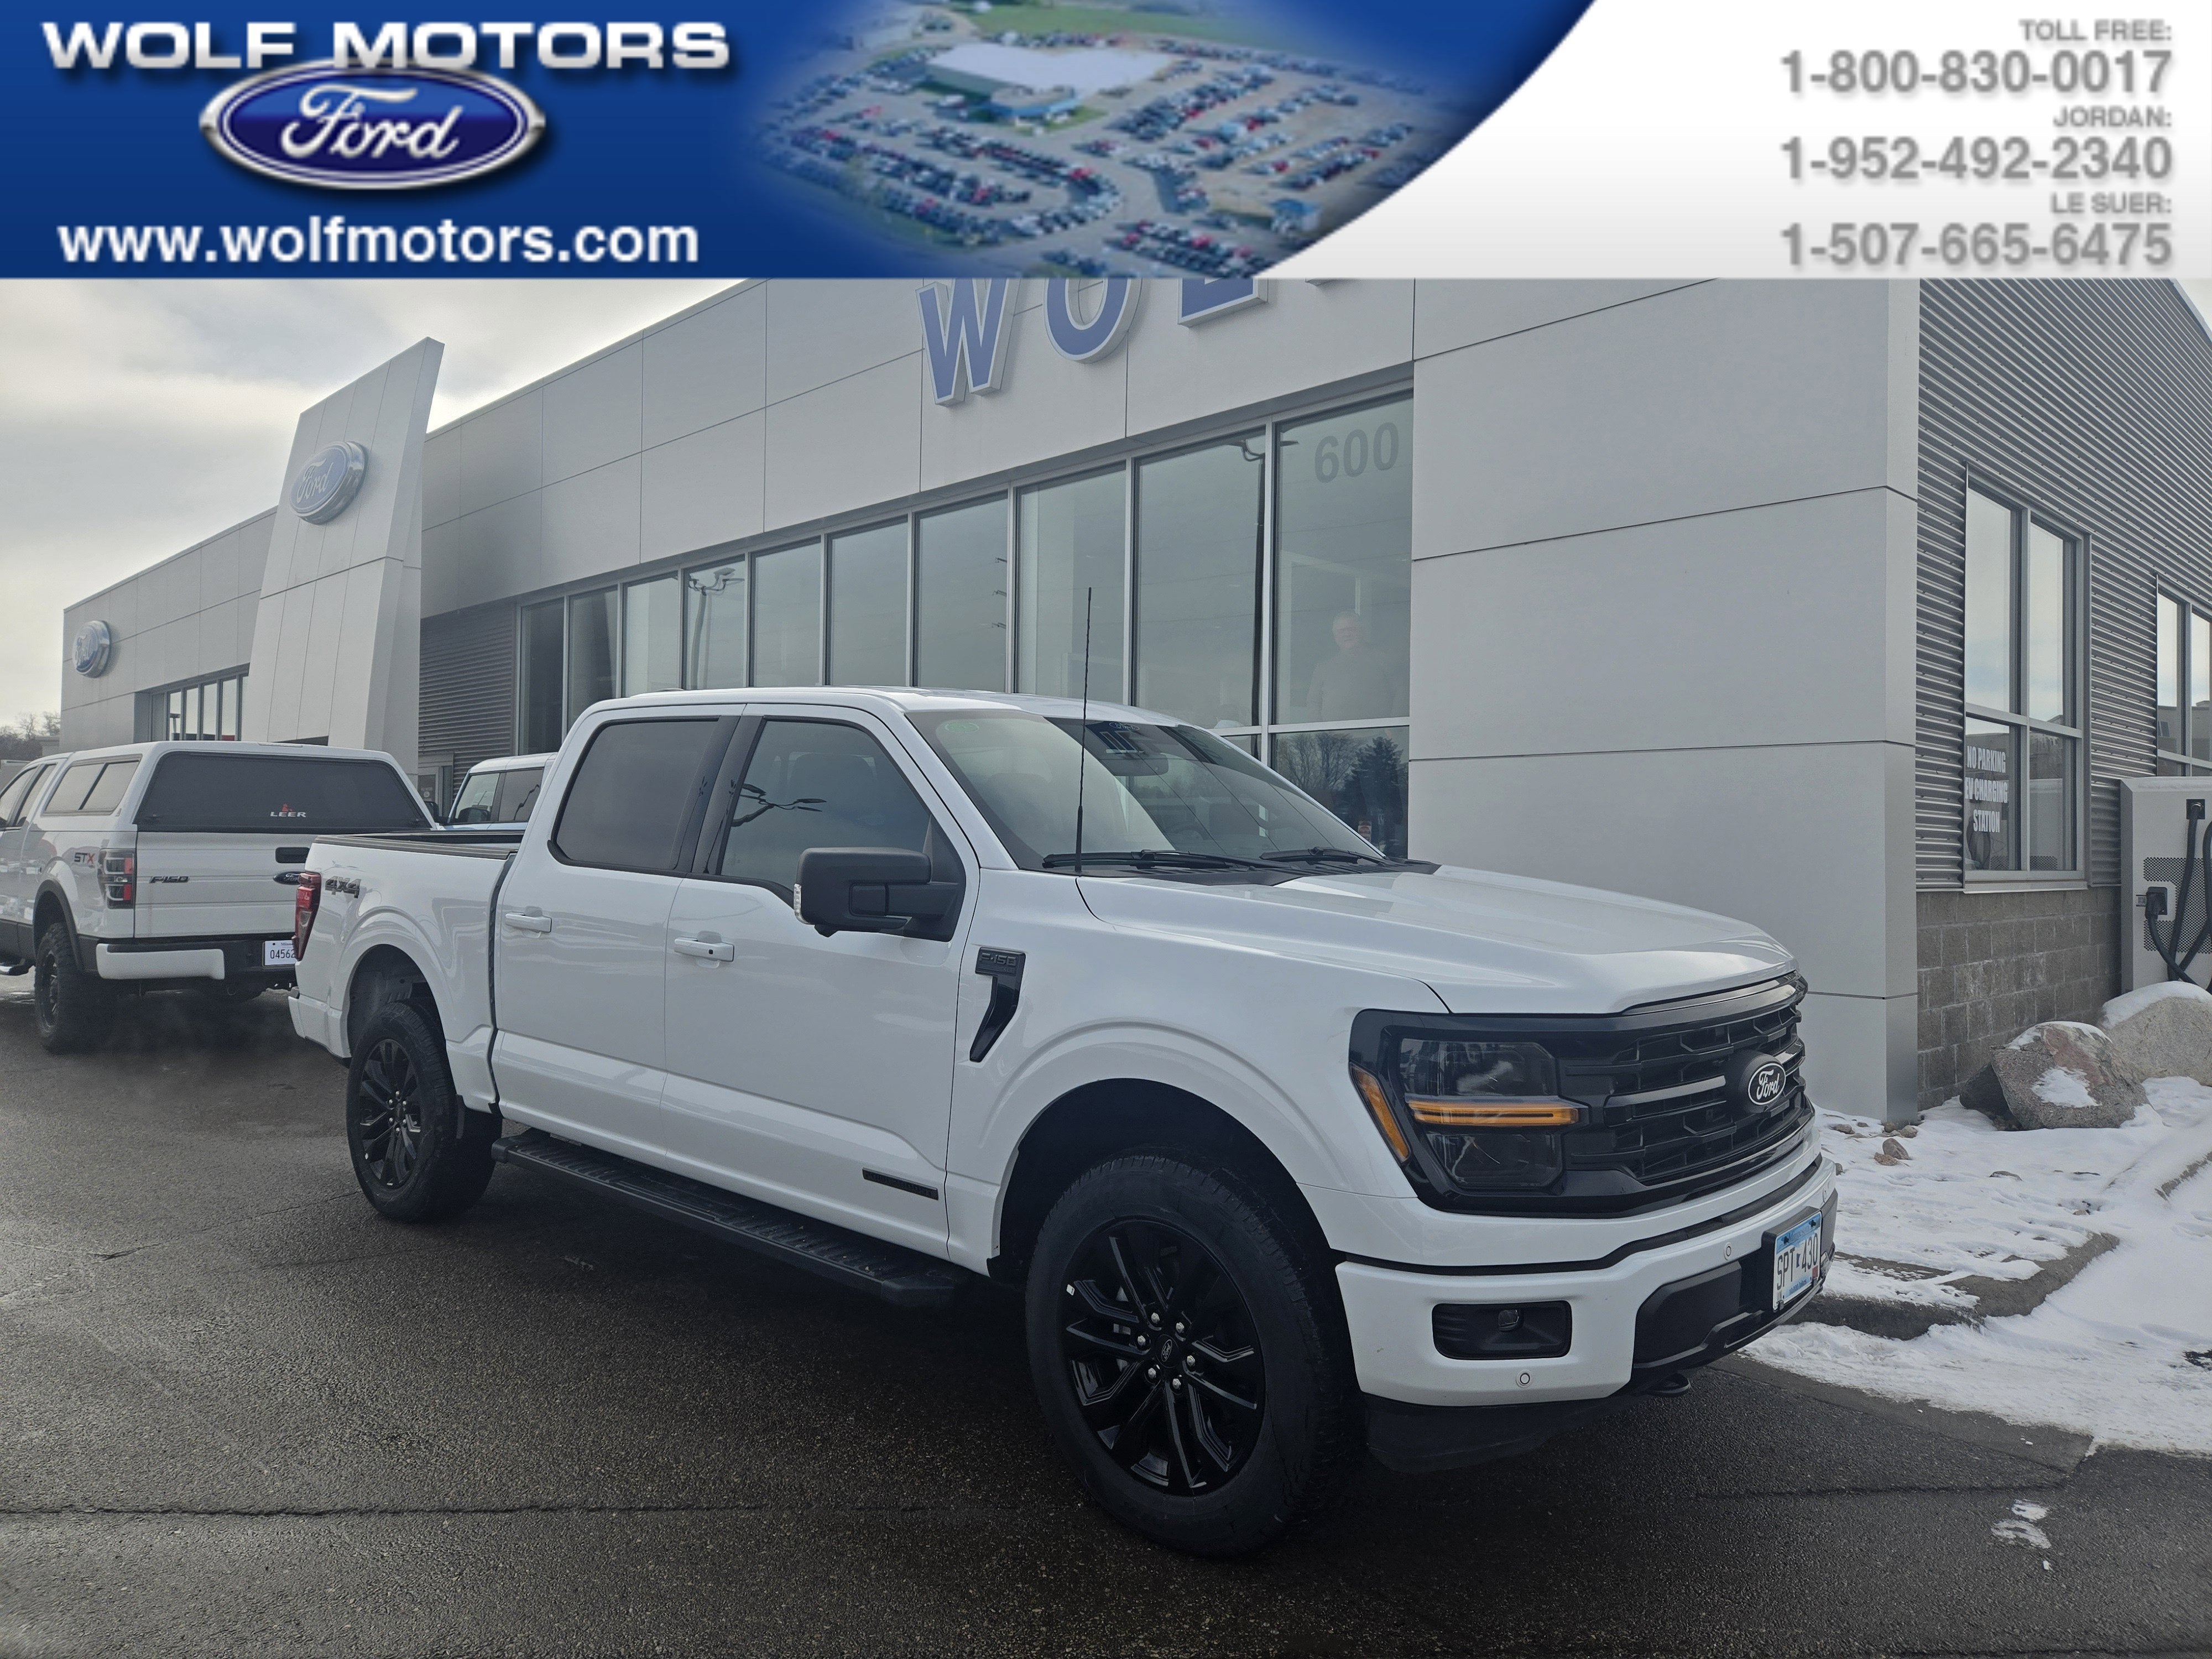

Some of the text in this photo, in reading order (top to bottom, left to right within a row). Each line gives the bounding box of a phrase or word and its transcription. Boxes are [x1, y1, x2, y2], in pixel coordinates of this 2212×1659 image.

[1314, 422, 1399, 483] 600
[296, 458, 334, 503] Ford
[1967, 745, 2006, 773] NO PARKING
[1965, 777, 2008, 804] EV CHARGING
[1973, 809, 2000, 833] STATION
[74, 852, 95, 864] STX
[978, 952, 1017, 966] F-150
[1756, 1069, 1780, 1100] Ford
[1777, 1233, 1818, 1290] SPT 430
